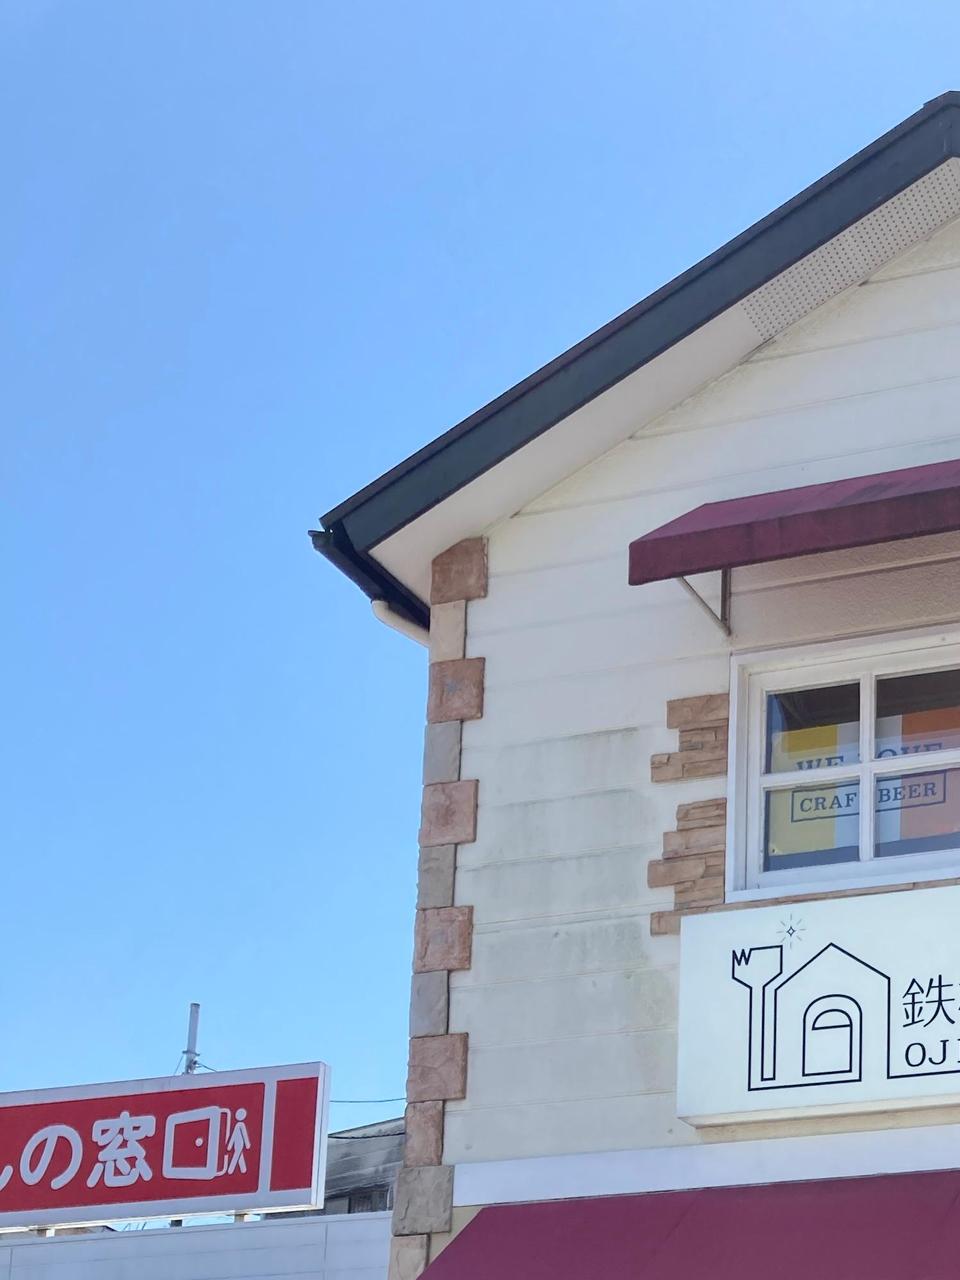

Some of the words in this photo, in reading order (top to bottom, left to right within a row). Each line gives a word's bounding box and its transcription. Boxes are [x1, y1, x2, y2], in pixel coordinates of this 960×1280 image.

[800, 792, 859, 812] CRAF
[877, 782, 937, 804] BEER
[0, 1104, 231, 1192] の窓口
